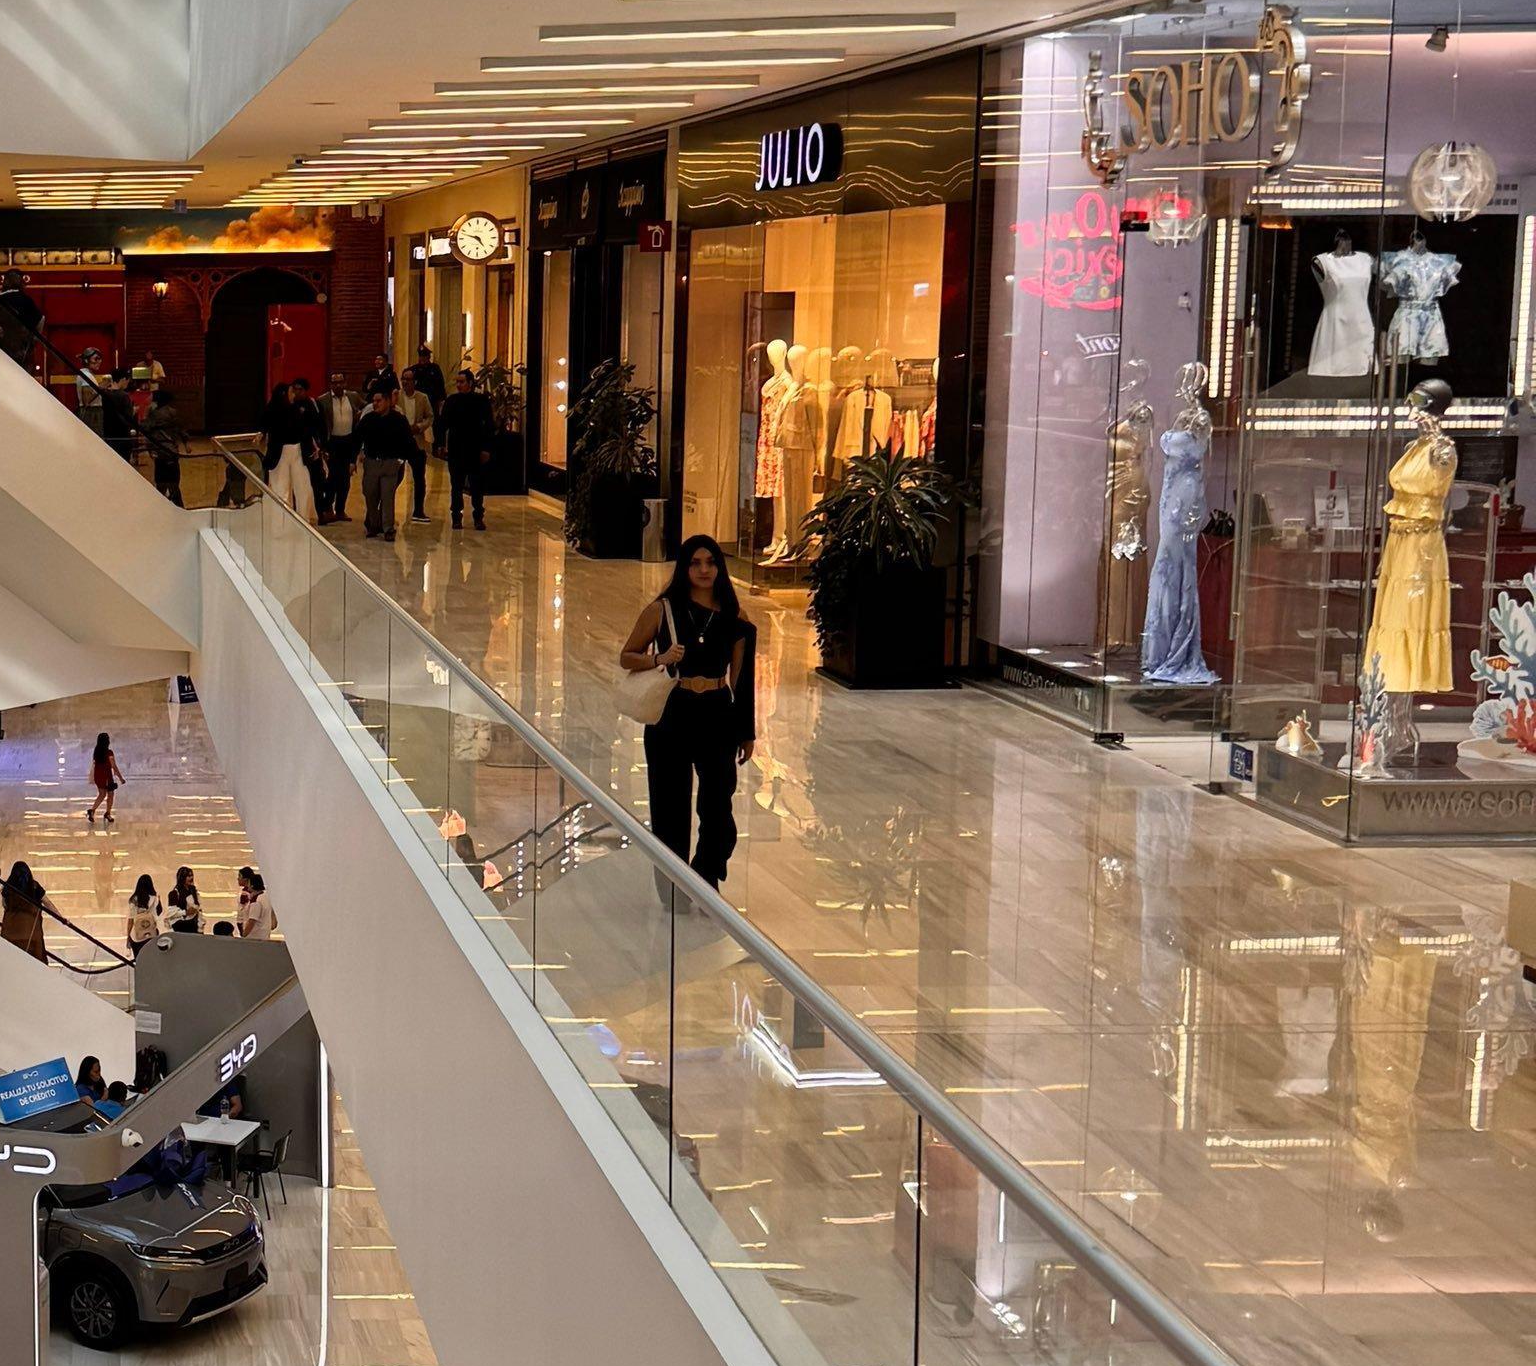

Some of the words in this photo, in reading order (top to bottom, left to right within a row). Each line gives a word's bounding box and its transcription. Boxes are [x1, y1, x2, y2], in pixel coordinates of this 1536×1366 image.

[1120, 52, 1256, 155] SOHO
[755, 122, 824, 191] JULIO
[220, 1033, 257, 1082] BYD
[0, 1086, 28, 1102] REALIZA
[35, 1073, 69, 1090] SOLICITUD
